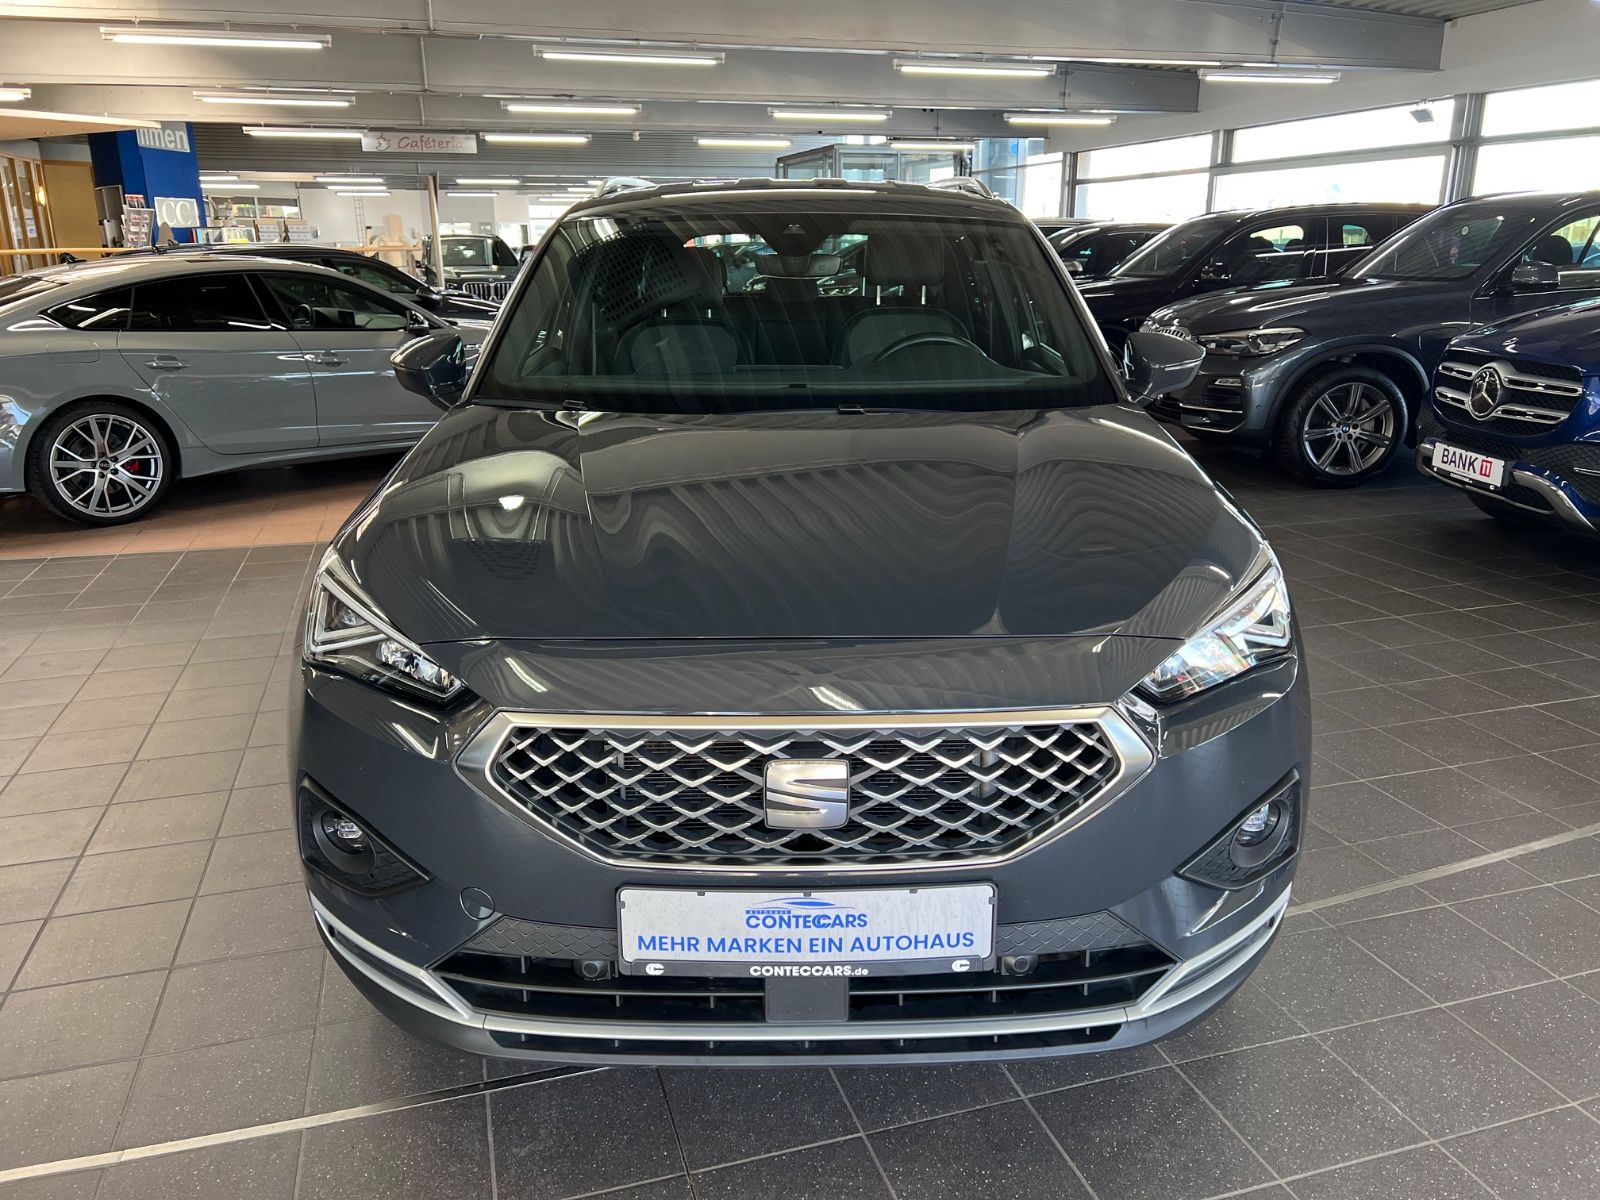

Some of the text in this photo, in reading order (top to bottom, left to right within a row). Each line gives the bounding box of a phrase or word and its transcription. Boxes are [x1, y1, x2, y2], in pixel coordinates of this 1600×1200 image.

[1441, 448, 1478, 473] BANK
[637, 932, 974, 953] MEHR MARKEN EIN AUTOHAUS
[749, 965, 869, 976] CONTECCARS.de
